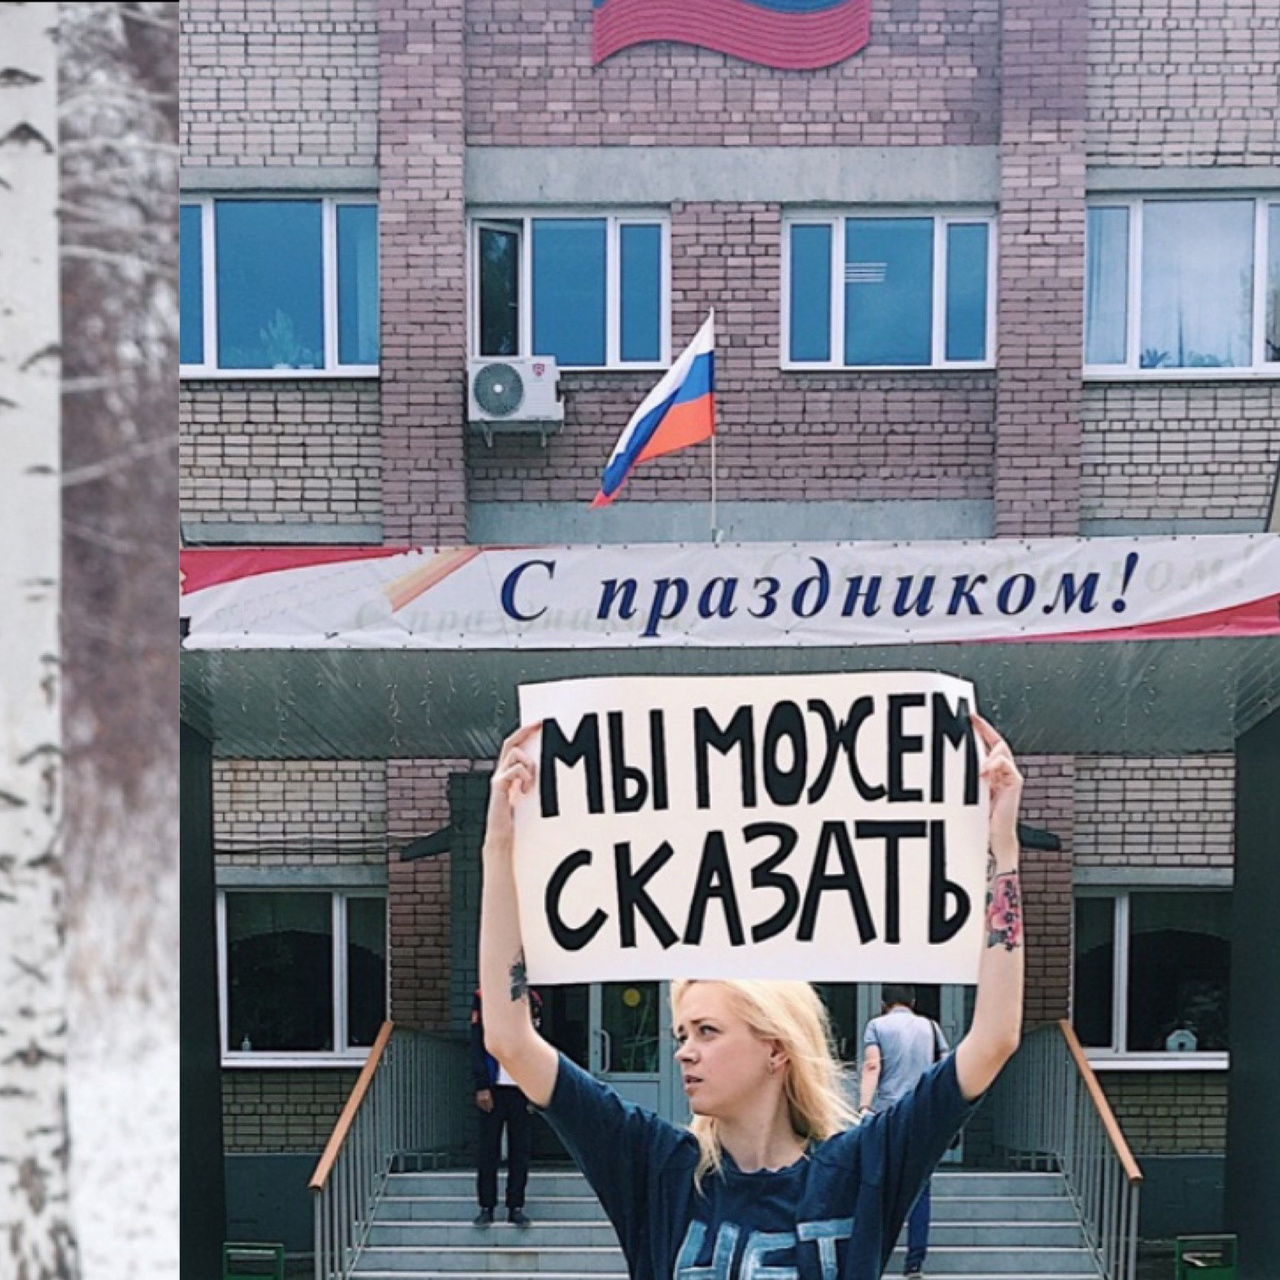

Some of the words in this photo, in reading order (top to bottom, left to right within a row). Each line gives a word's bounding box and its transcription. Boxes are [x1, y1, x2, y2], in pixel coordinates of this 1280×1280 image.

[500, 559, 556, 622] С
[596, 551, 1139, 638] праздником!
[540, 709, 669, 818] МЫ
[694, 692, 980, 807] МОЖЕМ
[545, 820, 971, 951] СКАЗАТЬ
